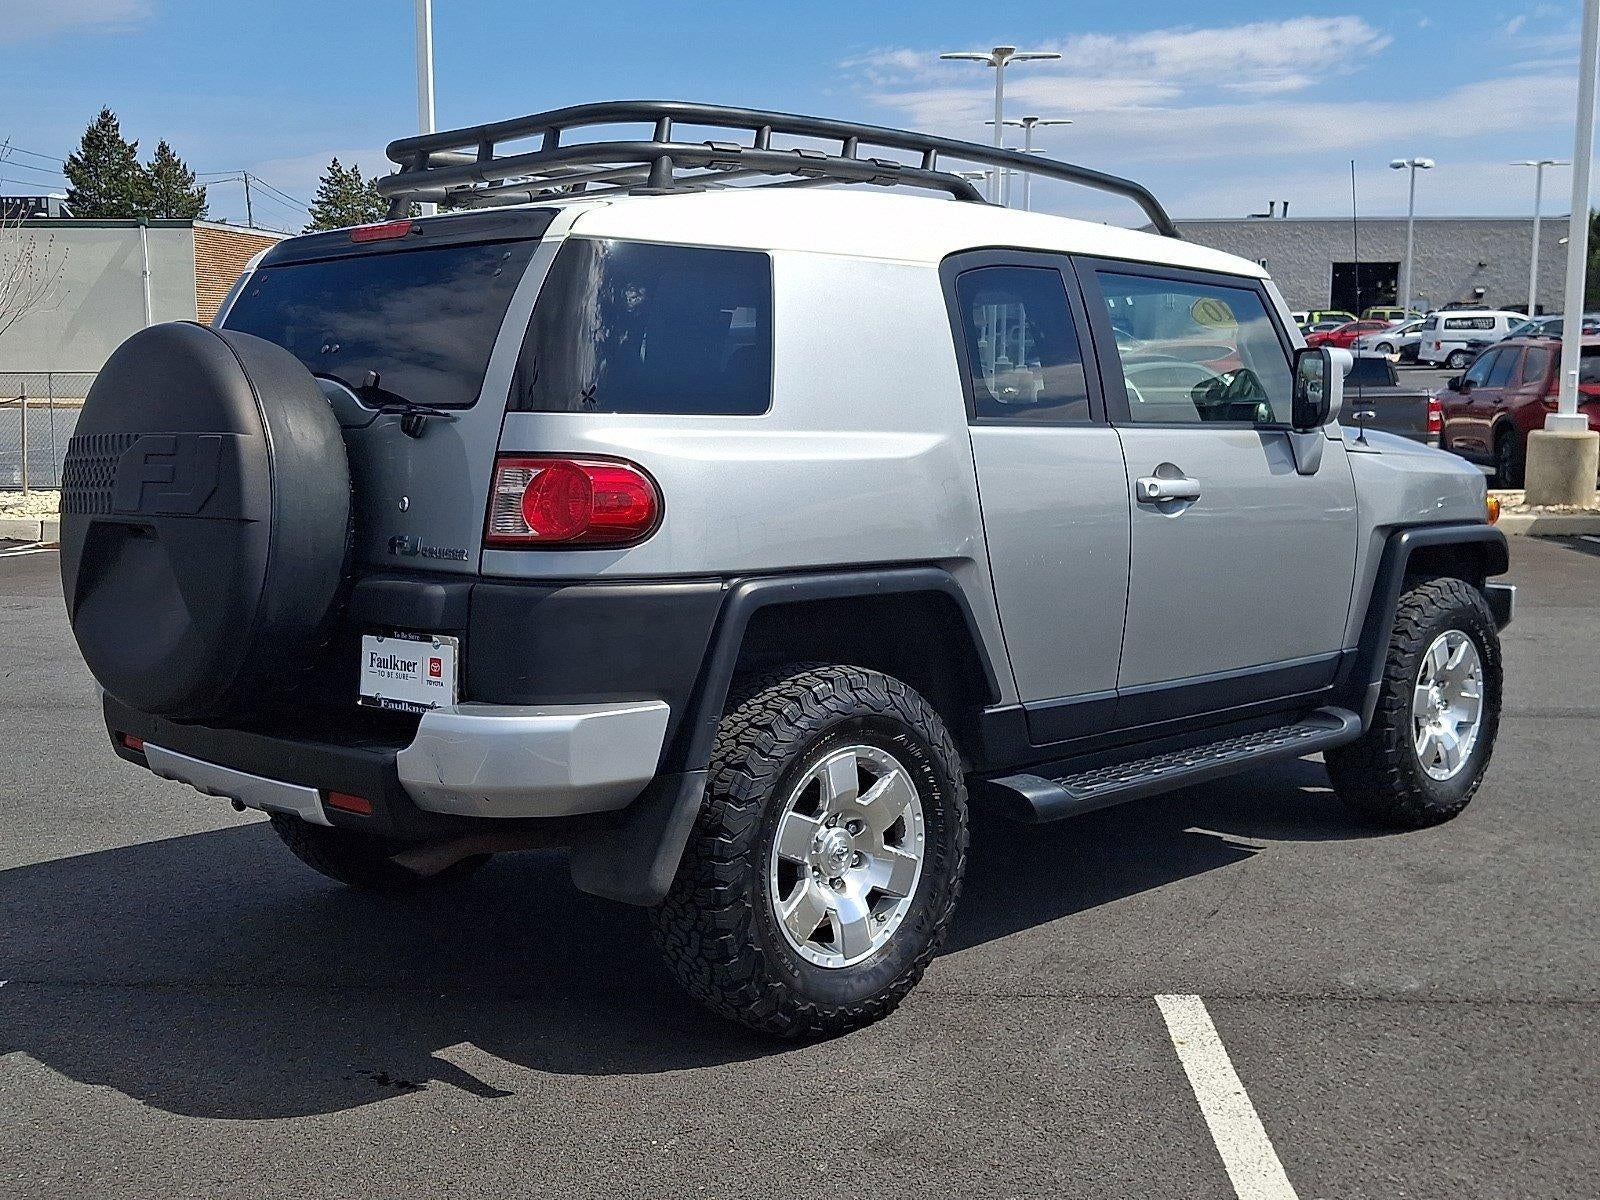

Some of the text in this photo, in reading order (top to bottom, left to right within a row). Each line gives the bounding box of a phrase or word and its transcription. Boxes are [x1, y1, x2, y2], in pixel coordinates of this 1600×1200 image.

[408, 633, 420, 641] Sure
[369, 651, 418, 673] Faulkner
[378, 670, 409, 681] TO BE SURE
